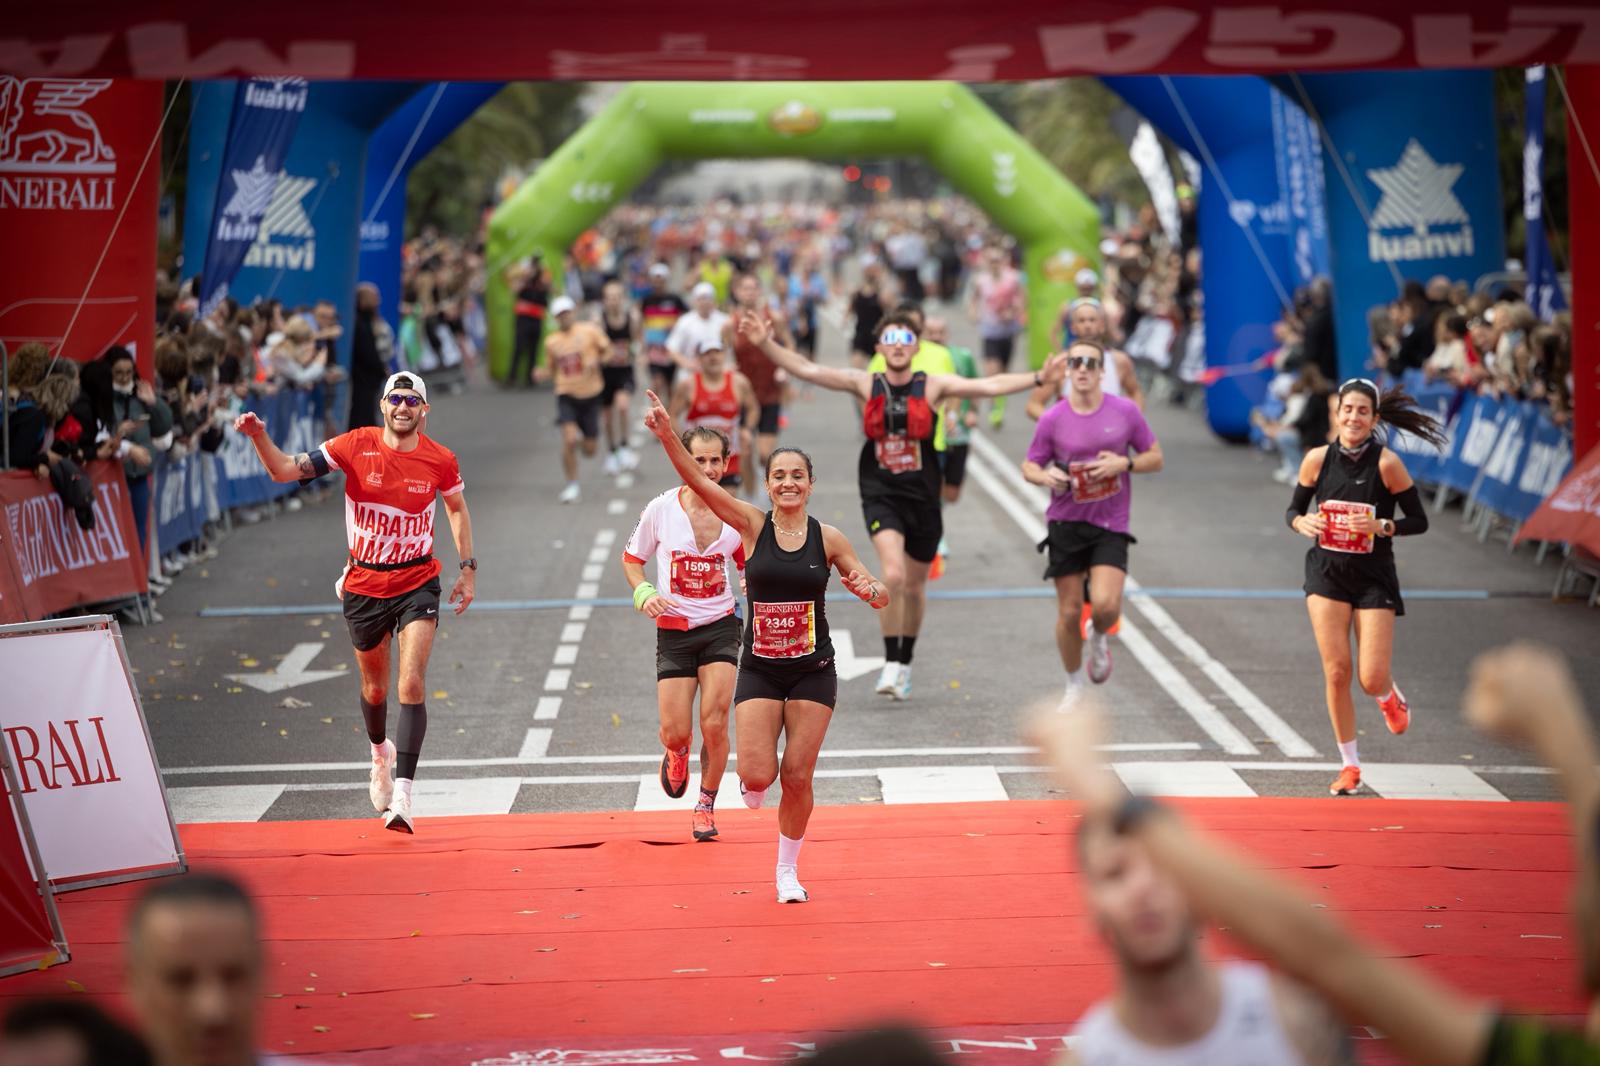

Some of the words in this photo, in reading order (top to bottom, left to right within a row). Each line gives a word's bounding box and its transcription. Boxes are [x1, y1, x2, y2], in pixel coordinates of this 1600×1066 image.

[0, 176, 116, 210] NERALI
[1367, 226, 1475, 263] luanvi
[684, 560, 711, 572] 1509
[766, 604, 805, 613] GENERALI
[765, 617, 796, 628] 2346
[3, 716, 121, 794] RALI
